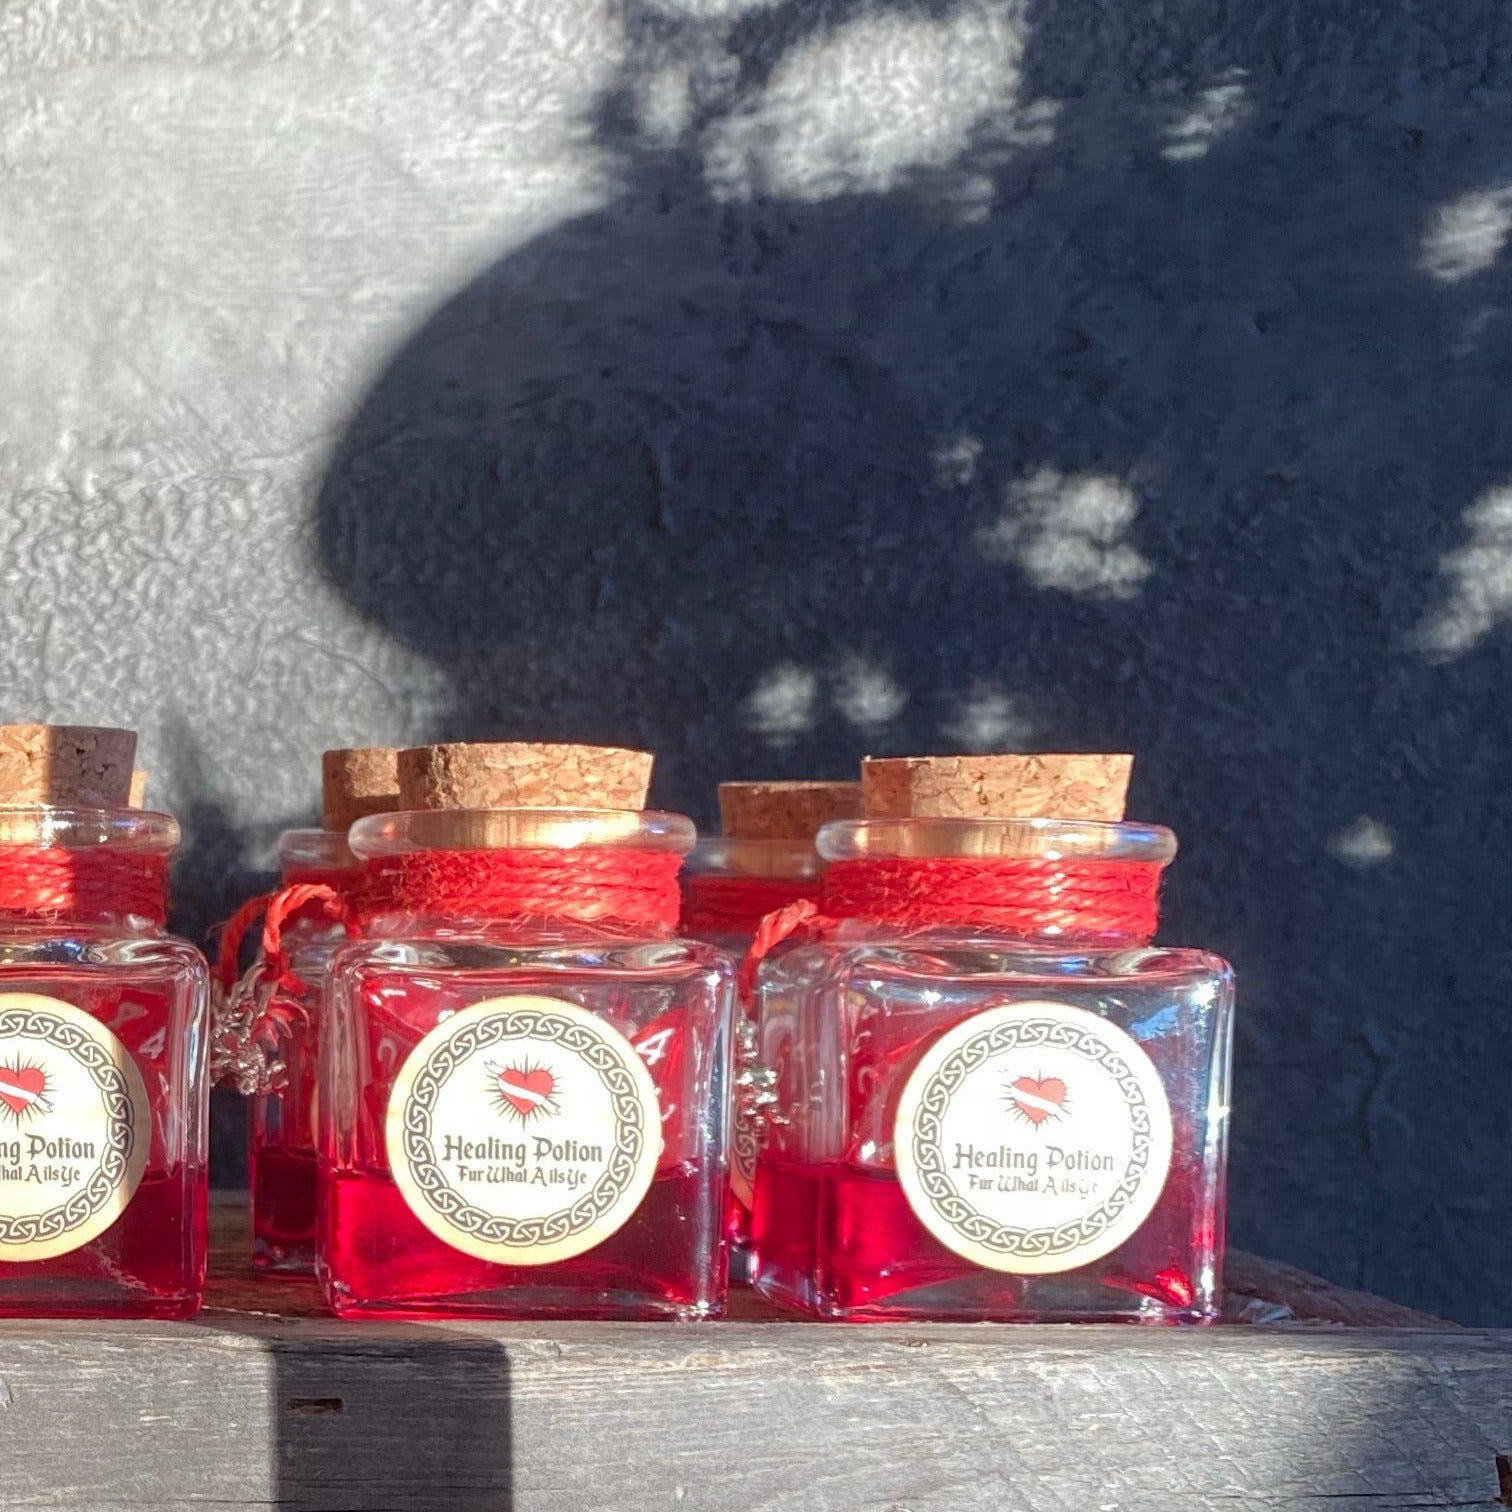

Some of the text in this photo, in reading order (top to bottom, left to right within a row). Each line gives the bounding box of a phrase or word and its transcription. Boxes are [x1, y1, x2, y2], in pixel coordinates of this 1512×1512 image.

[25, 1132, 95, 1160] Potion
[442, 1134, 603, 1167] Healing Potion
[952, 1143, 1114, 1176] Healing Potion
[24, 1165, 59, 1186] Ails
[60, 1165, 81, 1187] Ye
[455, 1166, 587, 1190] Fur What Ails Ye
[996, 1176, 1039, 1193] What
